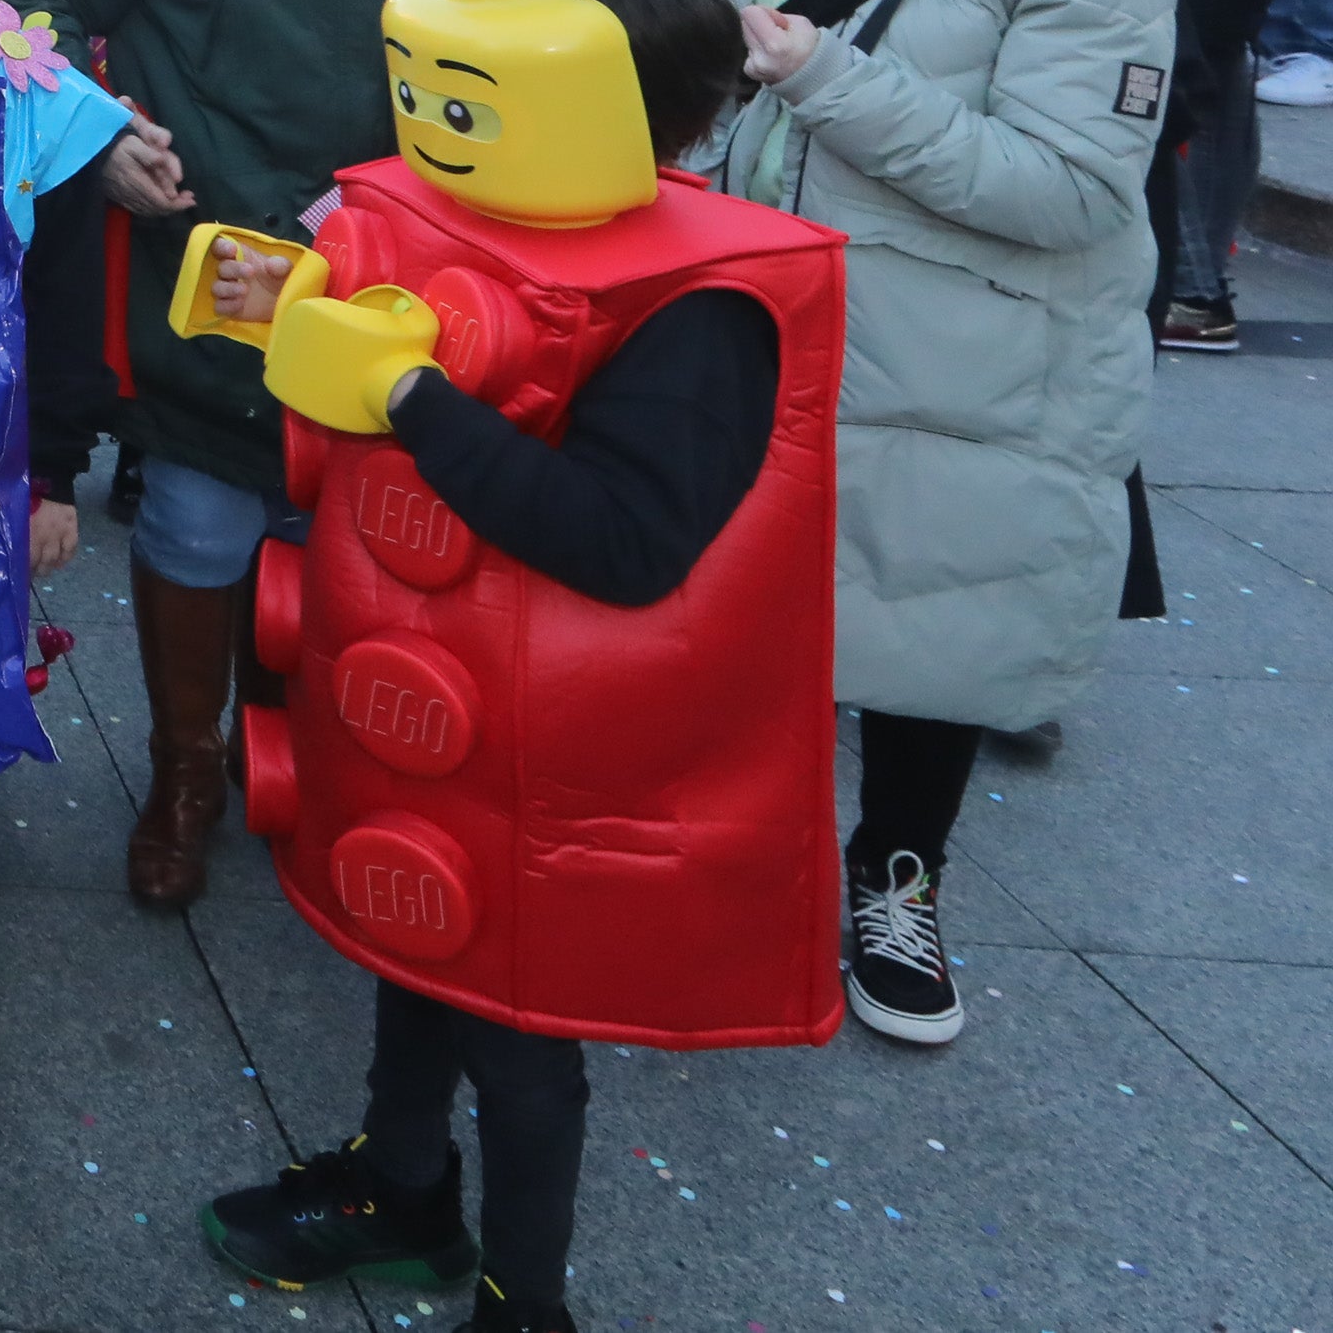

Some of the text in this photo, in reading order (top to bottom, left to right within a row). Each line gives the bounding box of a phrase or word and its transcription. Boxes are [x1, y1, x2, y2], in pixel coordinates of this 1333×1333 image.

[357, 477, 451, 556] LEGO
[340, 671, 447, 753] LEGO
[339, 861, 446, 931] LEGO
